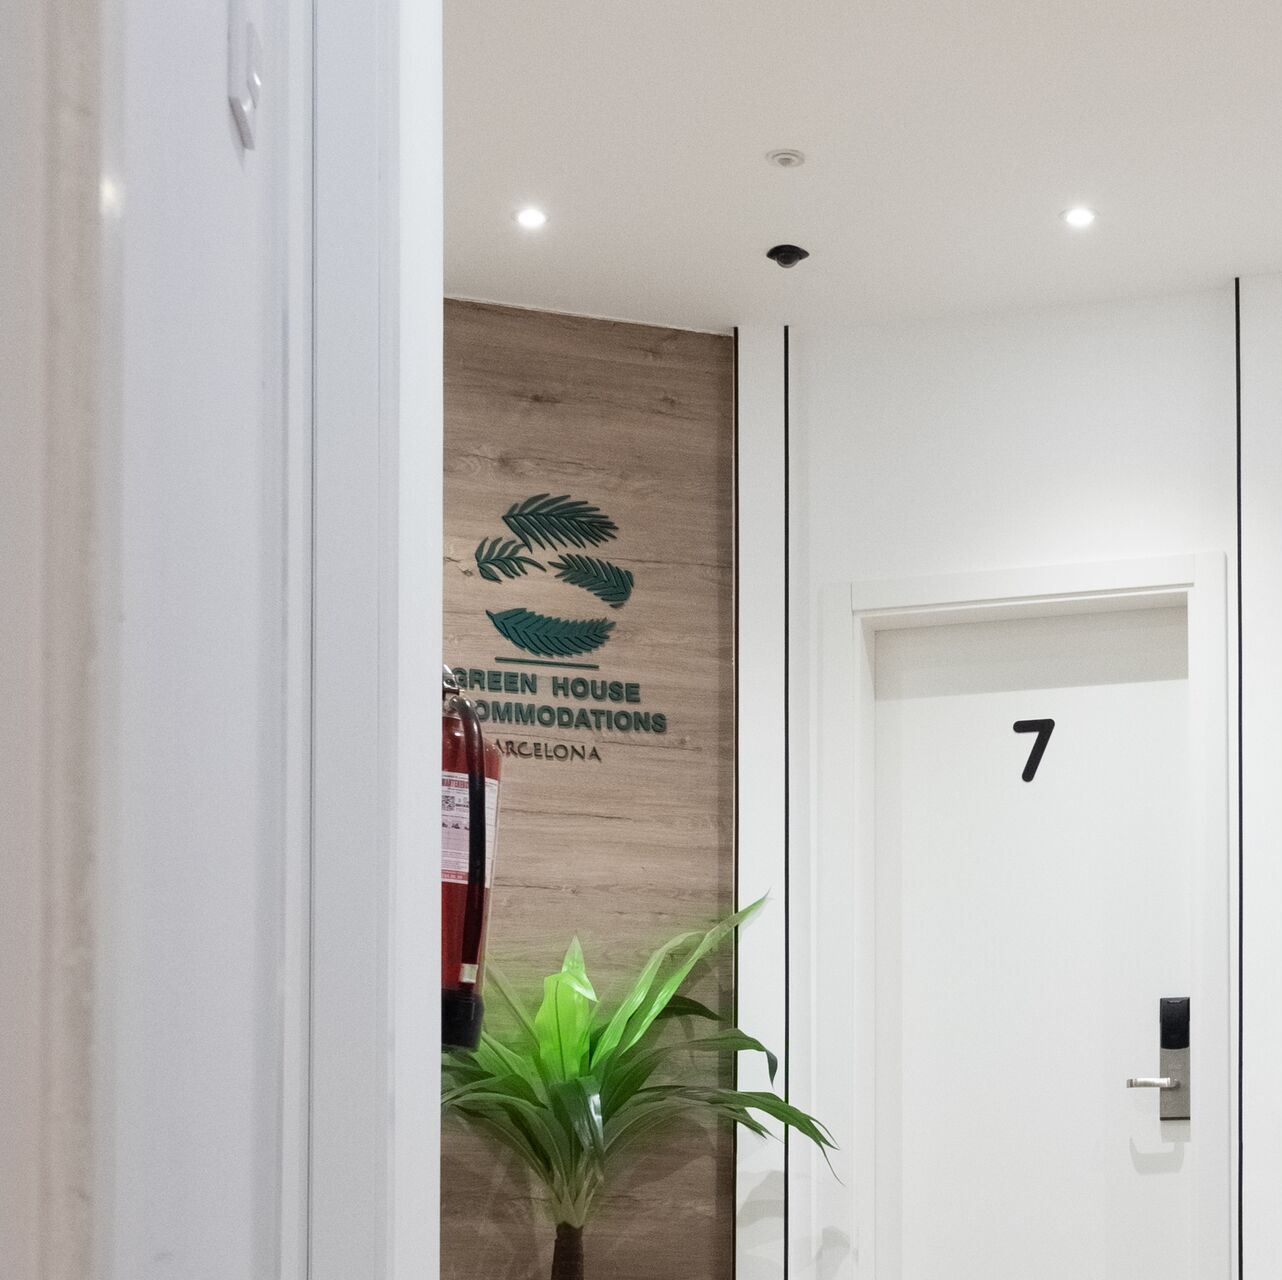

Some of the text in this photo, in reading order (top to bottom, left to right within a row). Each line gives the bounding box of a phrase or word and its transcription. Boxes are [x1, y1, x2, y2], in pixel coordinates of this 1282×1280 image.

[452, 667, 641, 703] GREEN HOUSE
[474, 699, 667, 733] OMMODATIONS
[495, 739, 602, 763] ARCELONA
[1013, 718, 1055, 782] 7
